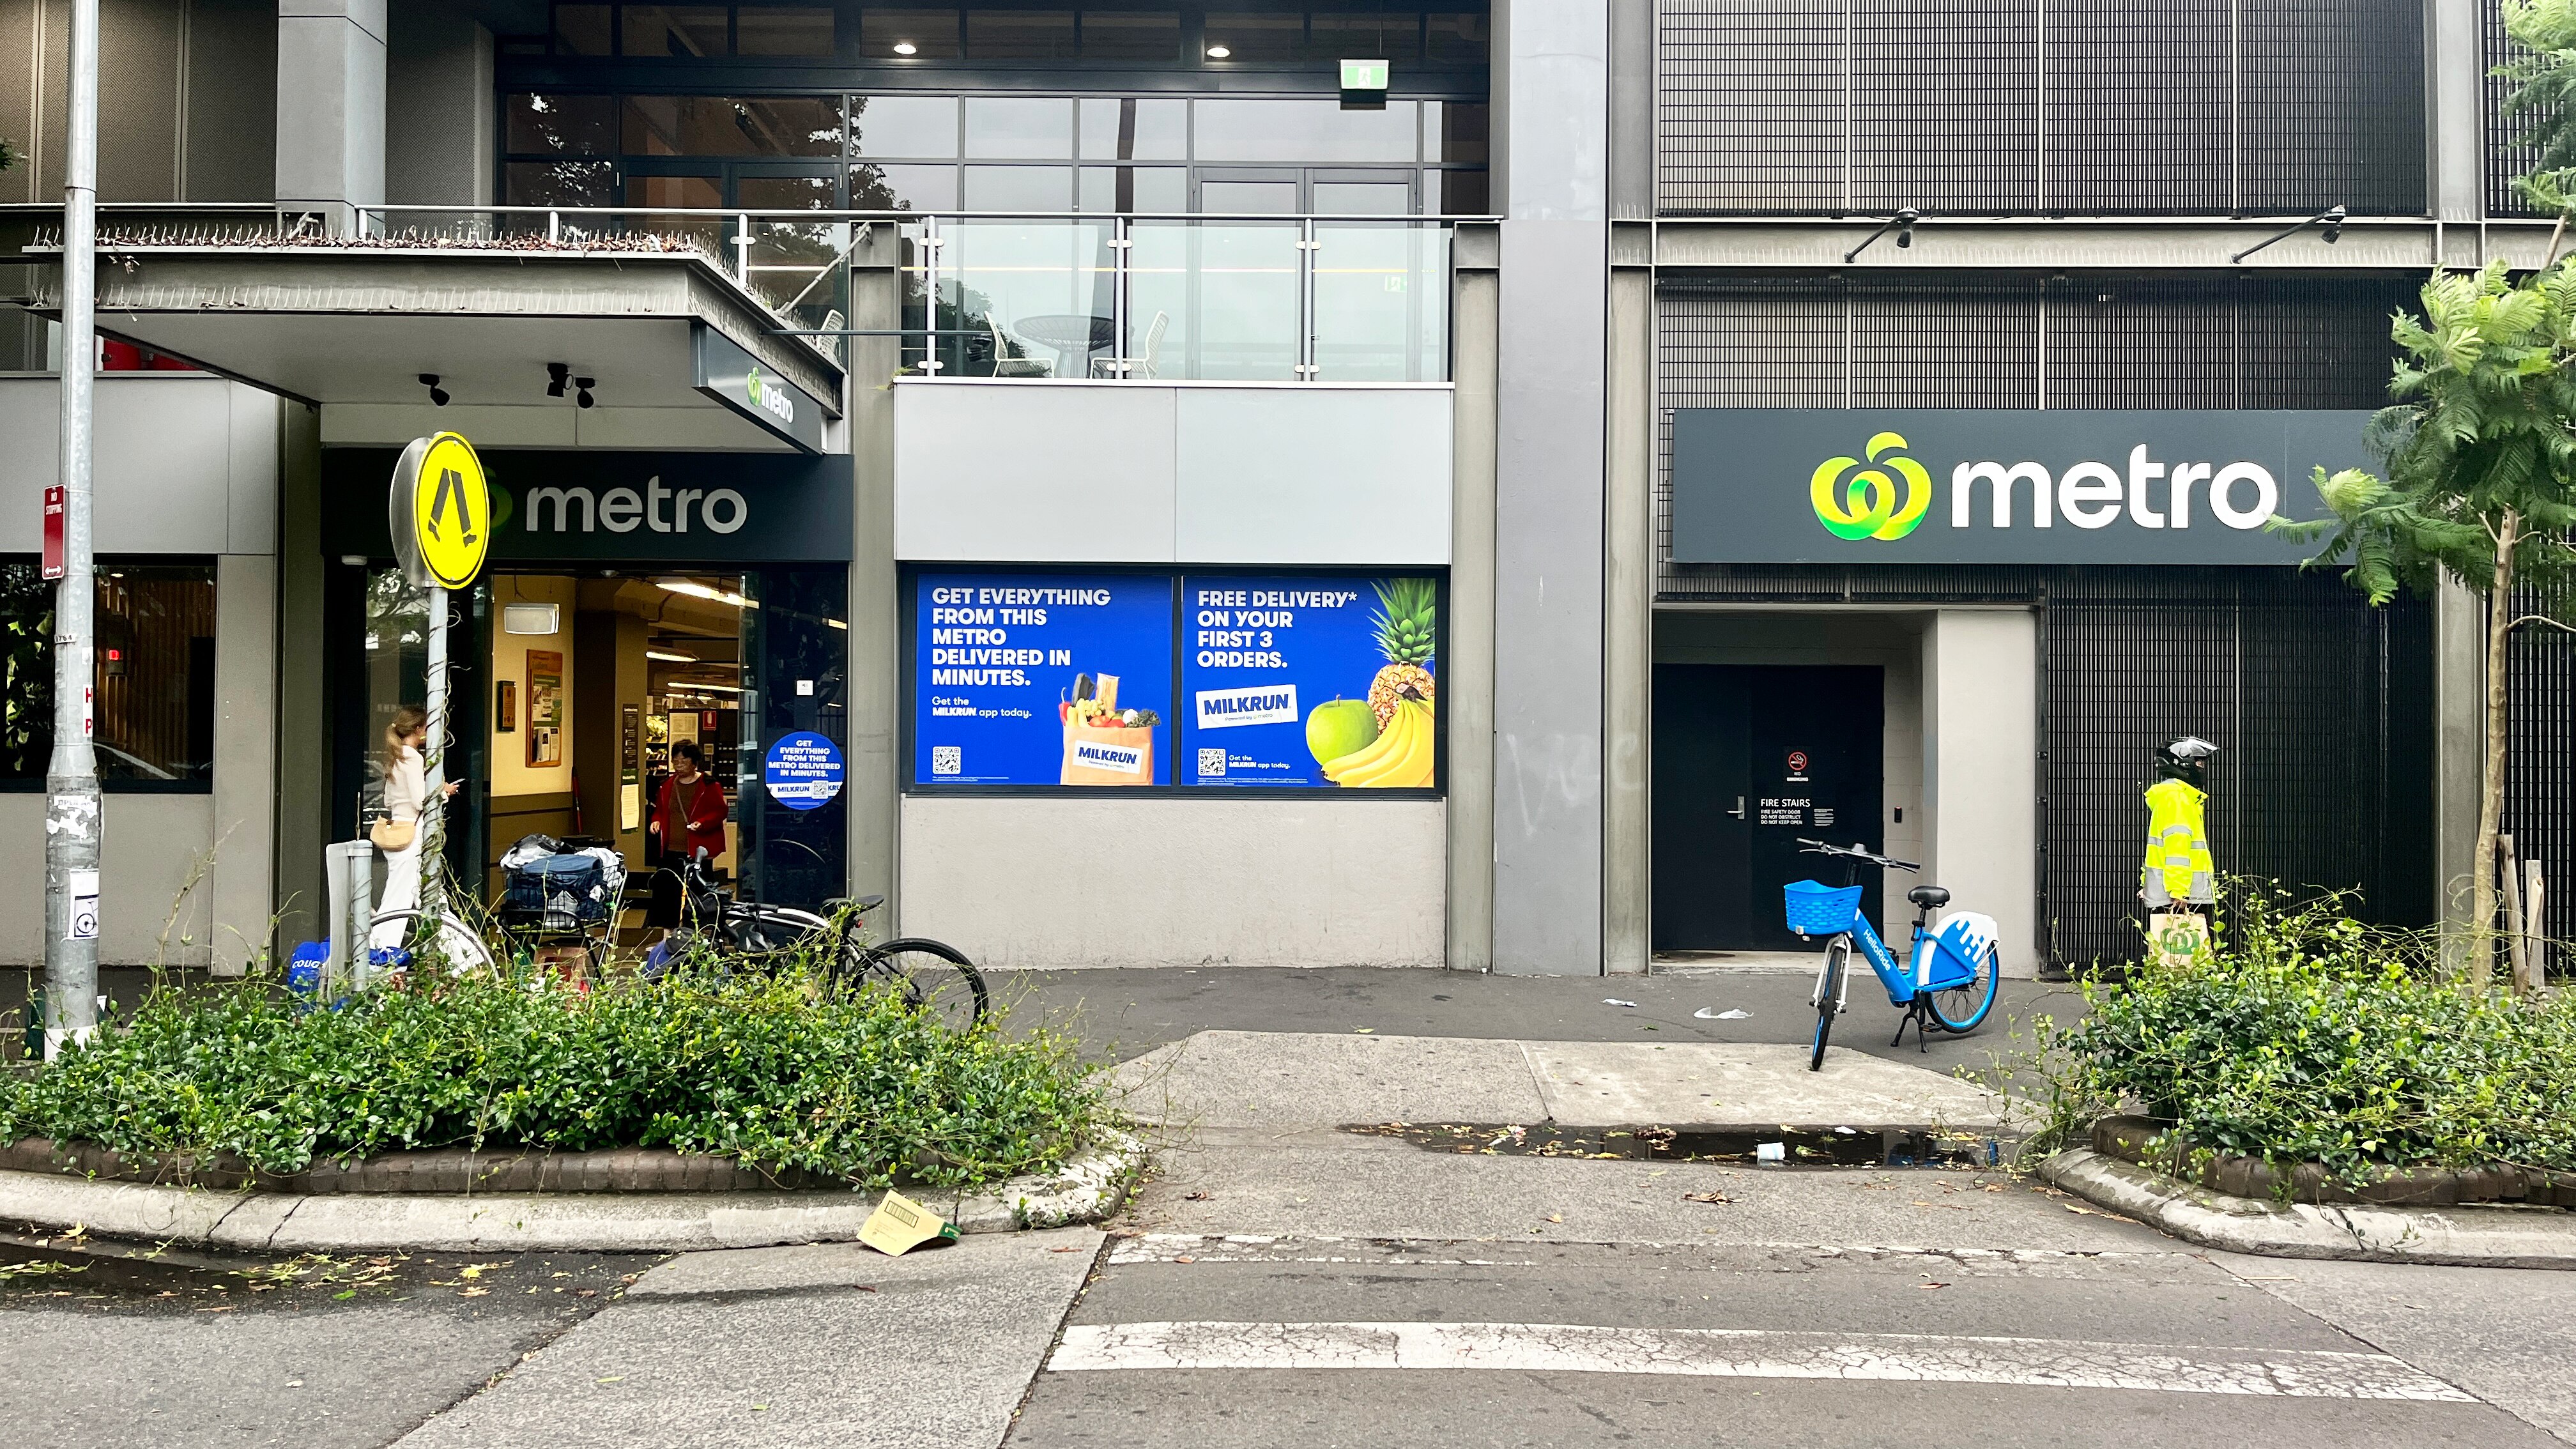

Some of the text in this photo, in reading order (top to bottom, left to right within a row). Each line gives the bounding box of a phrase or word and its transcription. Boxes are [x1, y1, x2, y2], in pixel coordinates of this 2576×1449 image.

[761, 382, 793, 423] metro
[1951, 443, 2277, 530] metro
[526, 475, 747, 533] metro
[932, 588, 1111, 606] GET EVERYTHING
[1198, 590, 1246, 607] FREE
[932, 608, 1047, 625] FROM THIS
[1197, 611, 1293, 628] ON YOUR
[932, 629, 1006, 645] METRO
[1198, 631, 1273, 648] FIRST 3
[932, 649, 1071, 666] DELIVERED IN
[1197, 651, 1288, 668] ORDERS.
[932, 669, 1031, 686] MINUTES.
[932, 696, 969, 705] Get the
[1204, 693, 1289, 716] MILKRUN
[932, 707, 1032, 719] MILKRUN app today.
[1078, 746, 1137, 764] MILKRUN
[1761, 799, 1811, 807] FIRE STAIRS
[1863, 928, 1891, 971] HelloRide
[292, 960, 326, 969] COUG
